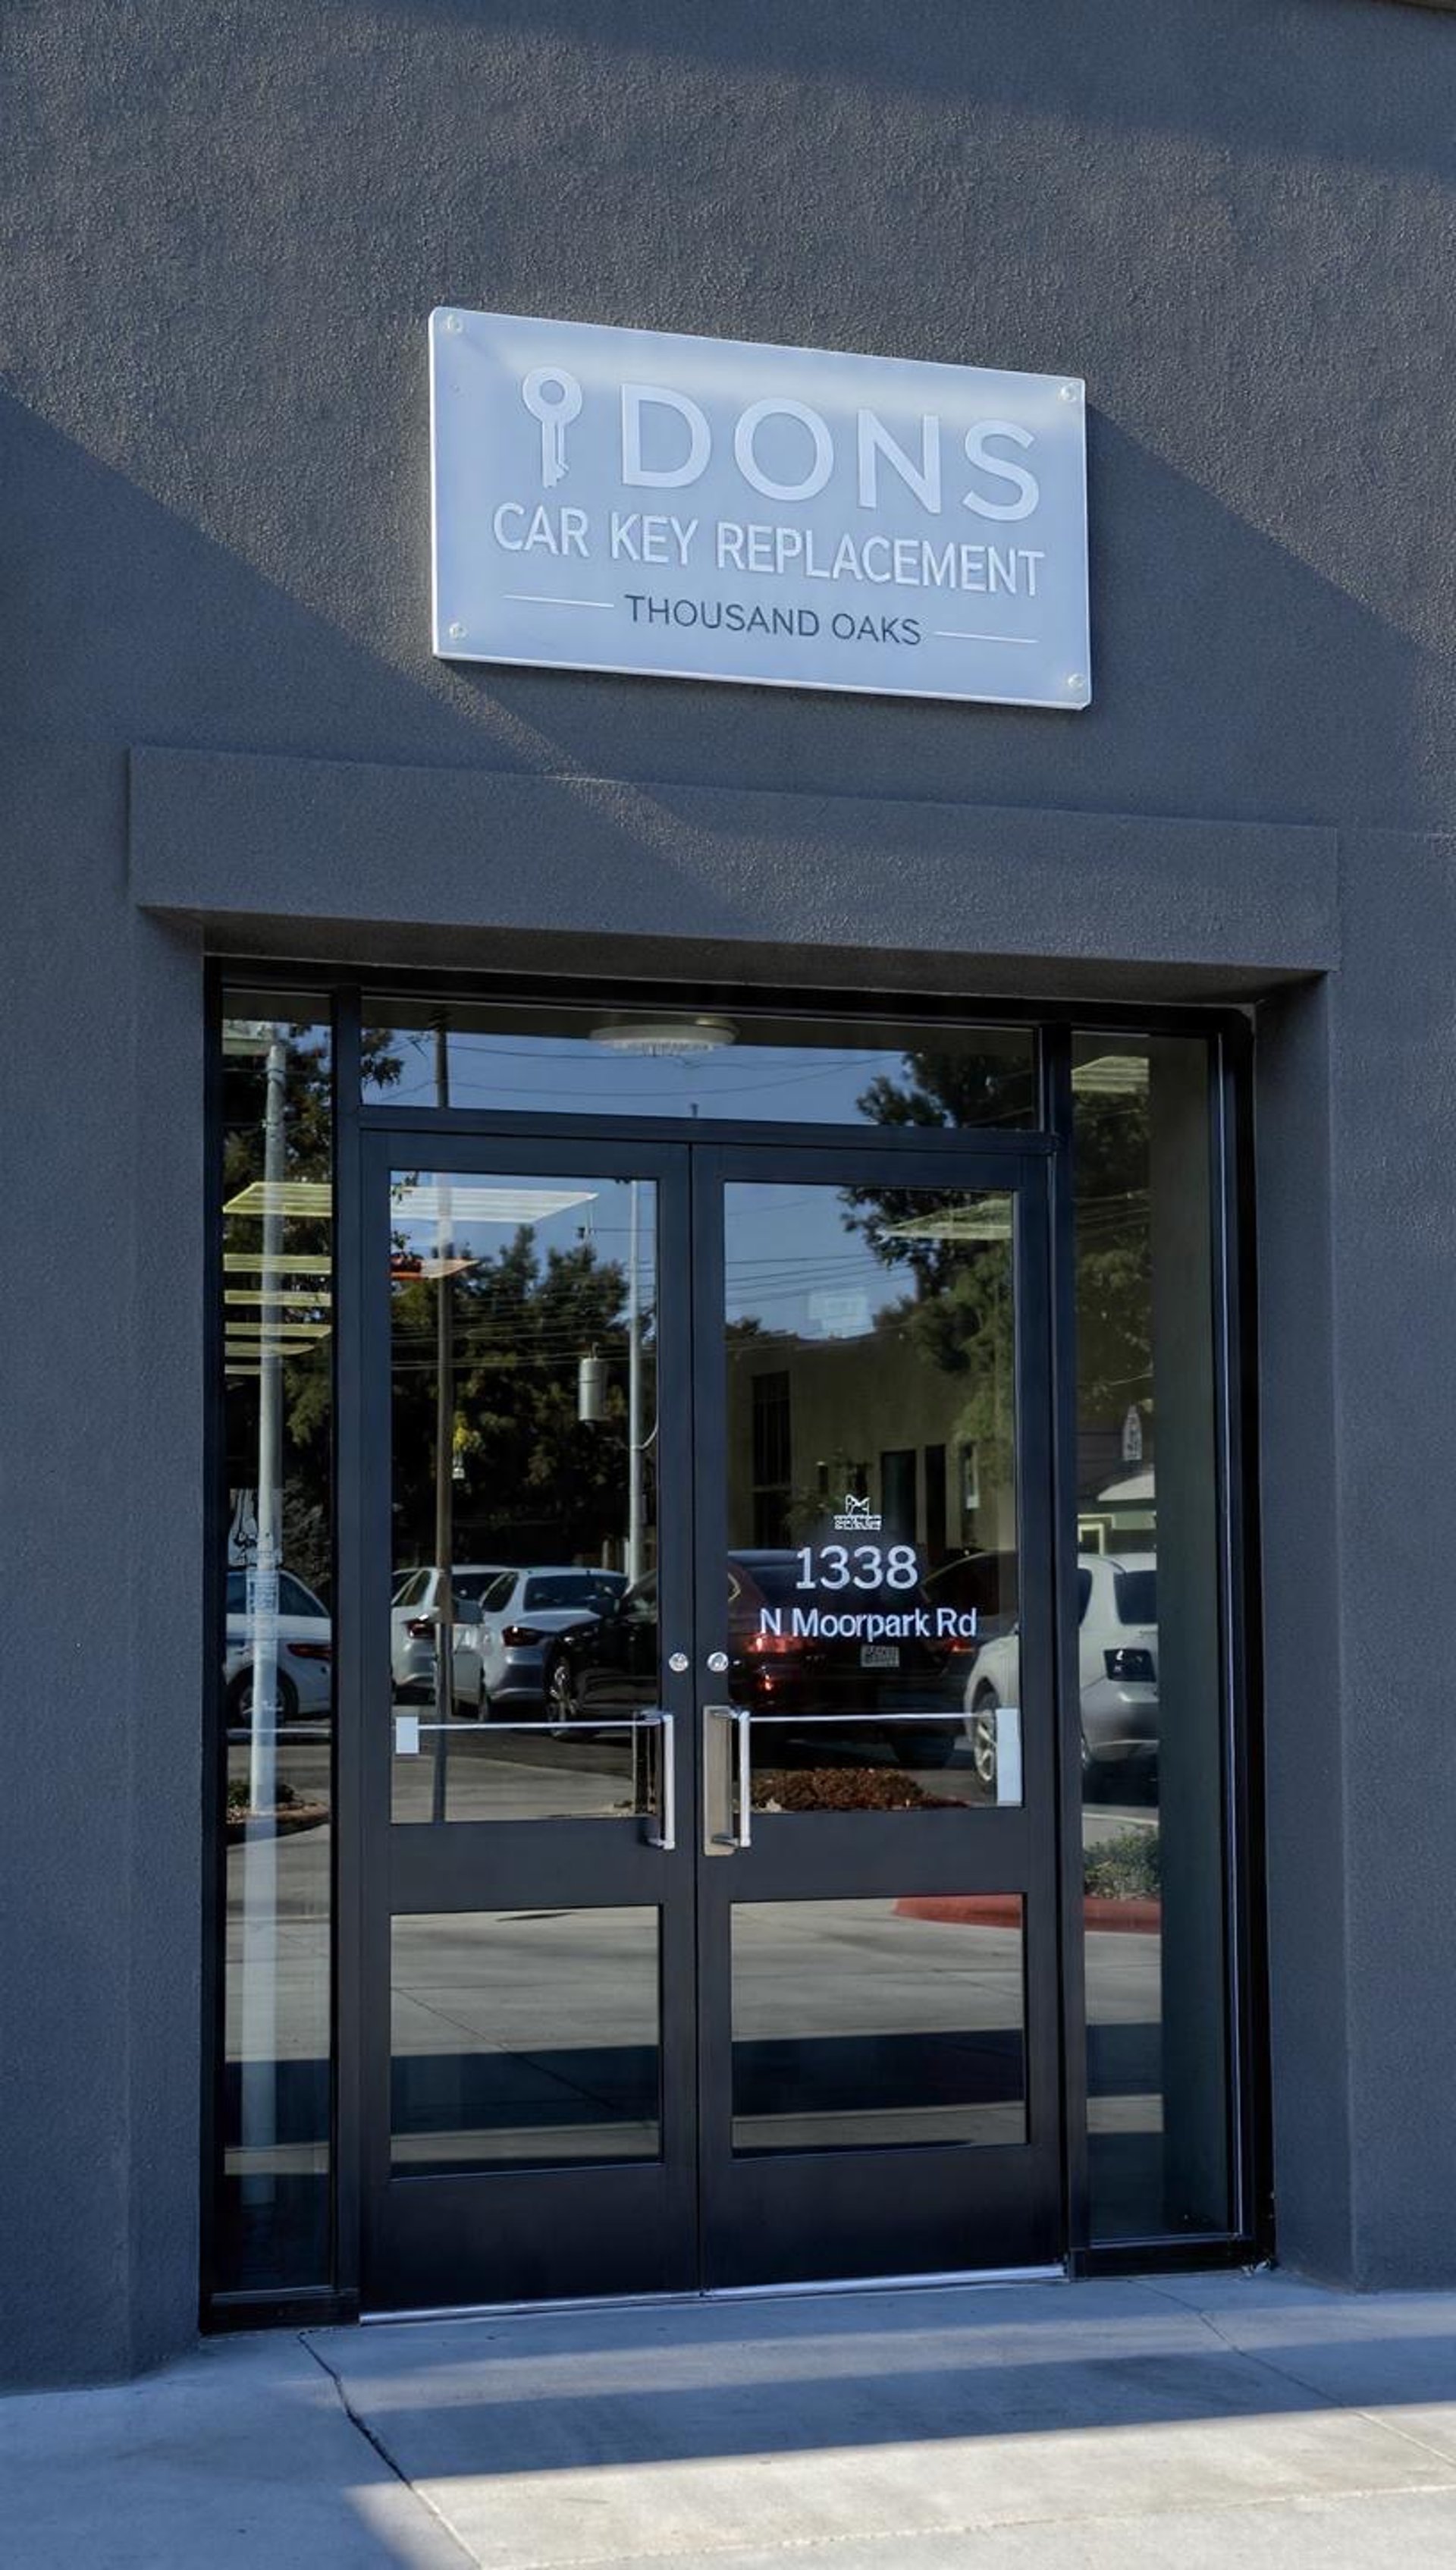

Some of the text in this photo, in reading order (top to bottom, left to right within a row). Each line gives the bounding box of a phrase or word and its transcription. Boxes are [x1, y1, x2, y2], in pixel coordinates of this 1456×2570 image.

[620, 384, 1041, 522] DONS
[492, 501, 1046, 597] CAR KEY REPLACEMENT
[624, 594, 922, 646] THOUSAND OAKS
[795, 1544, 918, 1590] 1338
[759, 1607, 977, 1642] N Moorpark Rd
